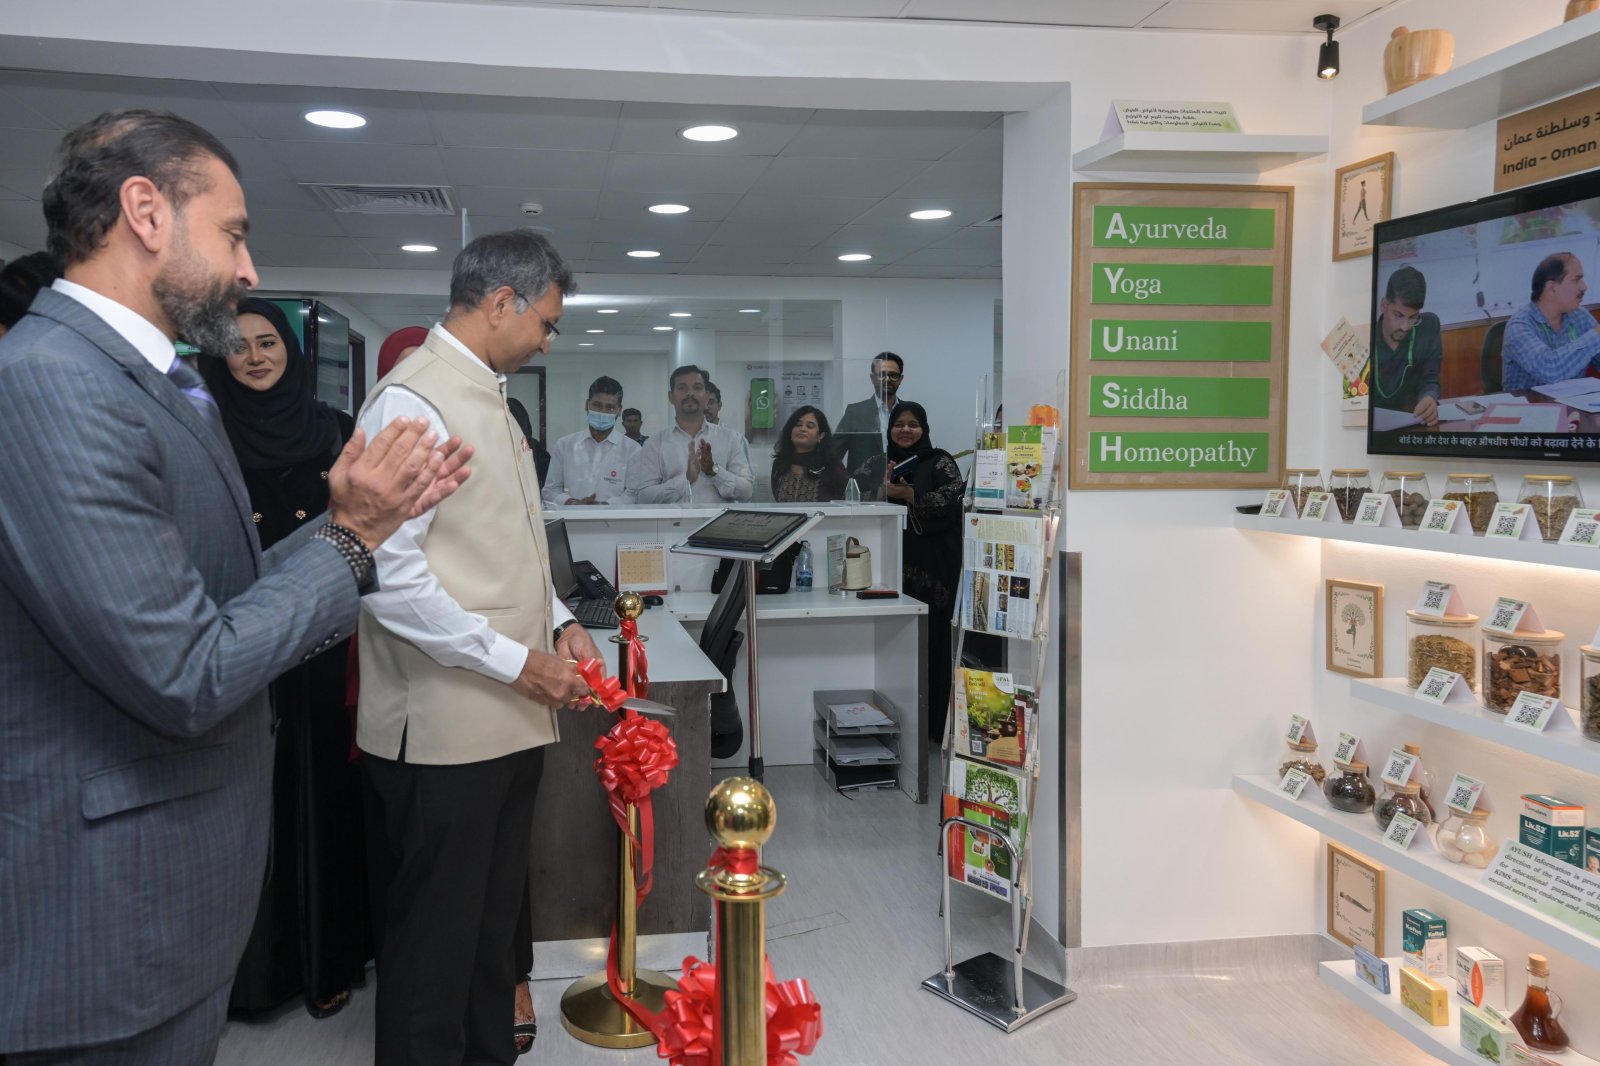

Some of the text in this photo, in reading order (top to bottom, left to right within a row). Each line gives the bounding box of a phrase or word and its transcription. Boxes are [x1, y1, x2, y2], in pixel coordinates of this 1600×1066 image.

[1503, 133, 1533, 152] عمان
[1535, 115, 1590, 139] وسلطنة
[1503, 156, 1537, 175] India
[1551, 140, 1597, 161] Oman
[1104, 212, 1228, 244] Ayurveda
[1103, 267, 1162, 299] Yoga
[1102, 326, 1179, 353] Unani
[1102, 382, 1188, 410] Siddha
[1100, 435, 1257, 467] Homeopathy
[1459, 436, 1477, 447] बाहर
[1530, 435, 1541, 447] को
[1571, 436, 1584, 449] देने
[1586, 436, 1597, 449] के
[1504, 854, 1531, 869] direction
[1542, 870, 1553, 879] the
[1554, 875, 1585, 893] Embassy
[1587, 889, 1597, 897] of
[1509, 845, 1533, 859] AYUSH
[1534, 853, 1572, 877] Information
[1488, 877, 1513, 891] medical
[1493, 868, 1512, 881] KIMS
[1512, 877, 1526, 888] does
[1528, 885, 1538, 893] not
[1539, 889, 1565, 906] endorse
[1565, 902, 1580, 912] and
[1499, 861, 1509, 869] for
[1511, 867, 1549, 887] educational
[1551, 886, 1582, 902] purposes
